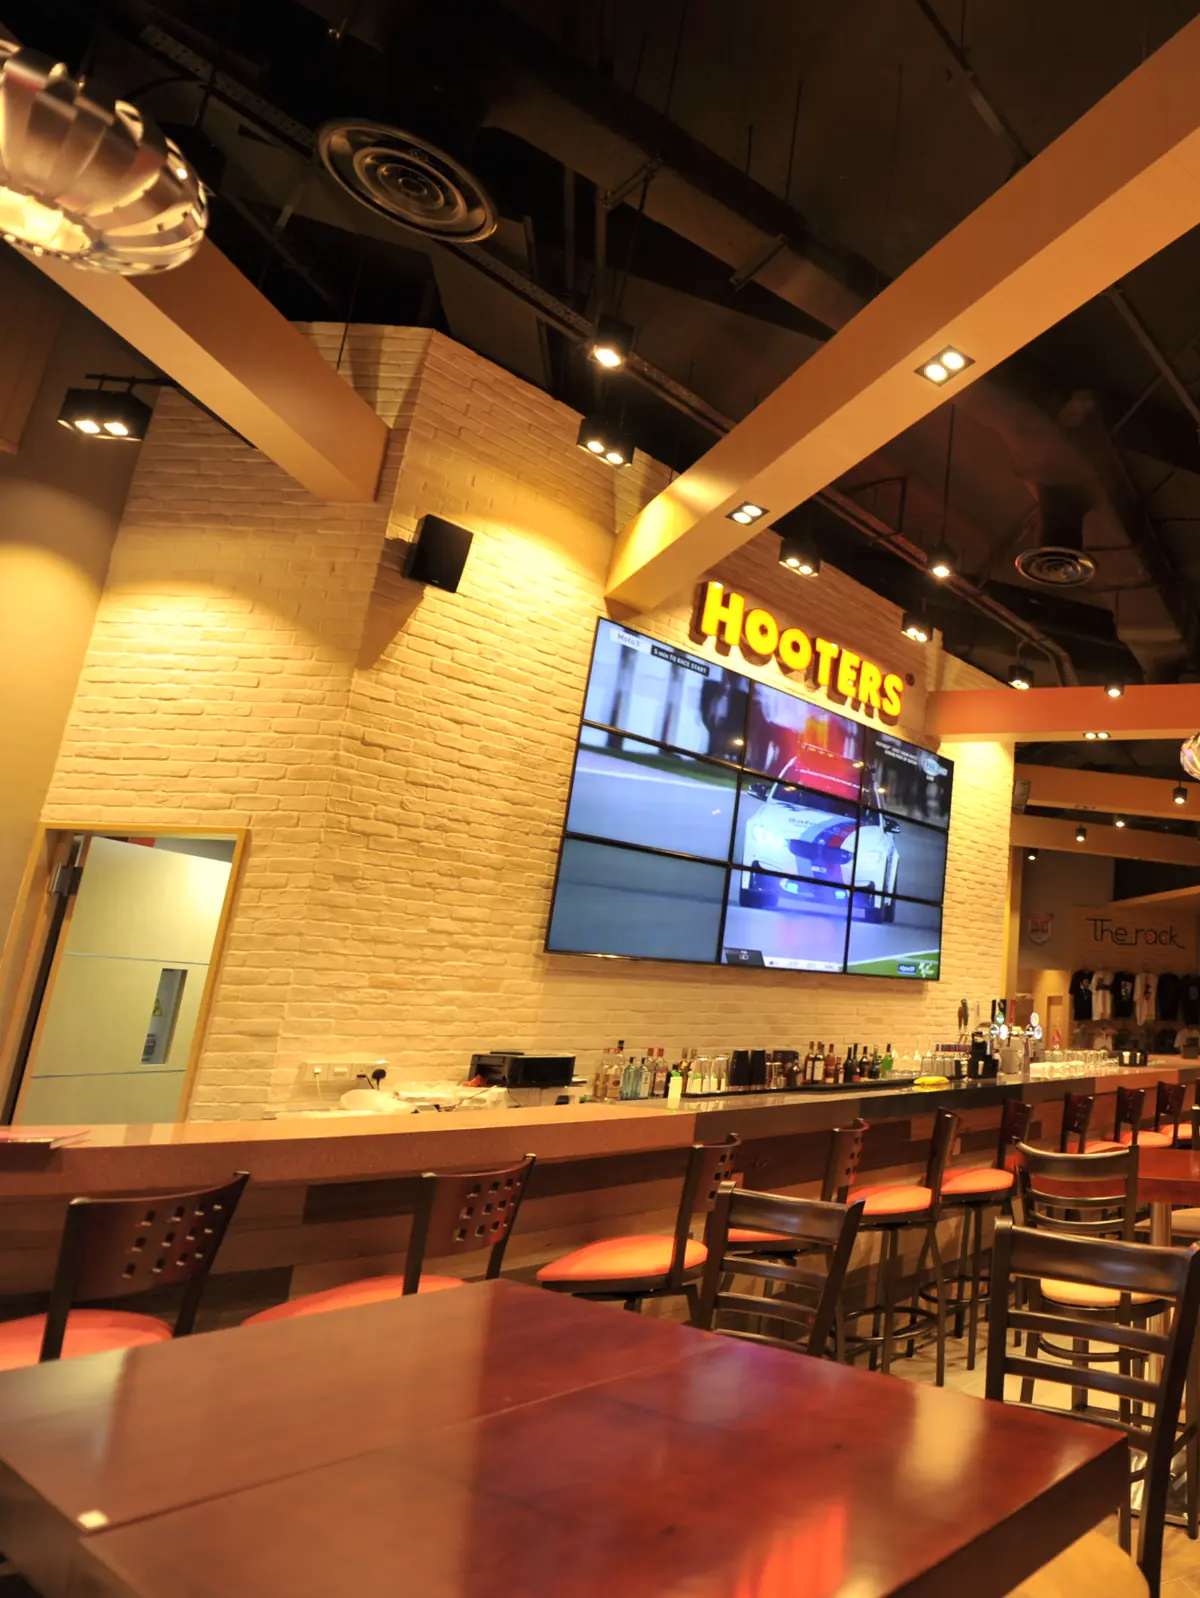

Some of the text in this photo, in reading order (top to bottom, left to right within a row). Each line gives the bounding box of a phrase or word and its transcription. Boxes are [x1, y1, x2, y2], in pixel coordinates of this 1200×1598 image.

[701, 581, 904, 716] HOOTERS
[691, 662, 708, 674] START
[1086, 917, 1185, 949] The rack
